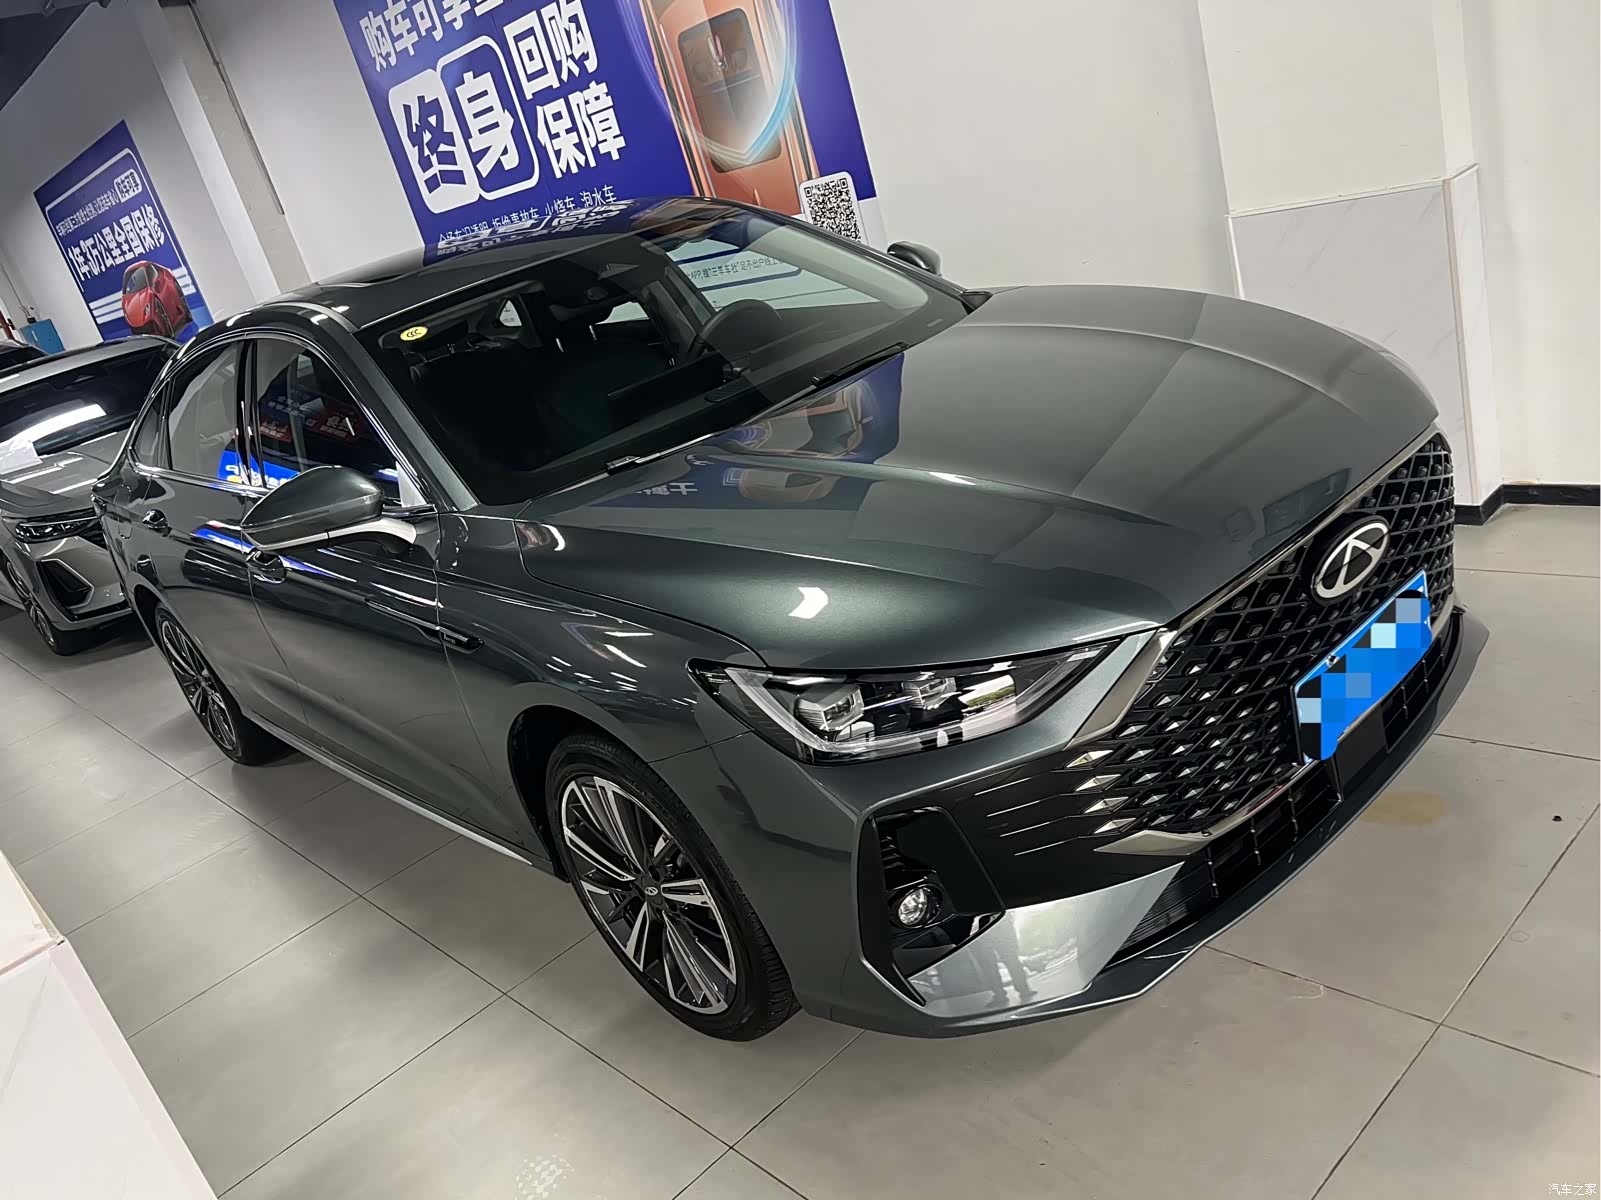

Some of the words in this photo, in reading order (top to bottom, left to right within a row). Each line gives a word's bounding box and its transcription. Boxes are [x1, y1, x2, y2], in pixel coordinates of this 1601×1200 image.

[503, 0, 599, 99] 回购
[403, 71, 520, 194] 终身
[536, 80, 627, 179] 保障
